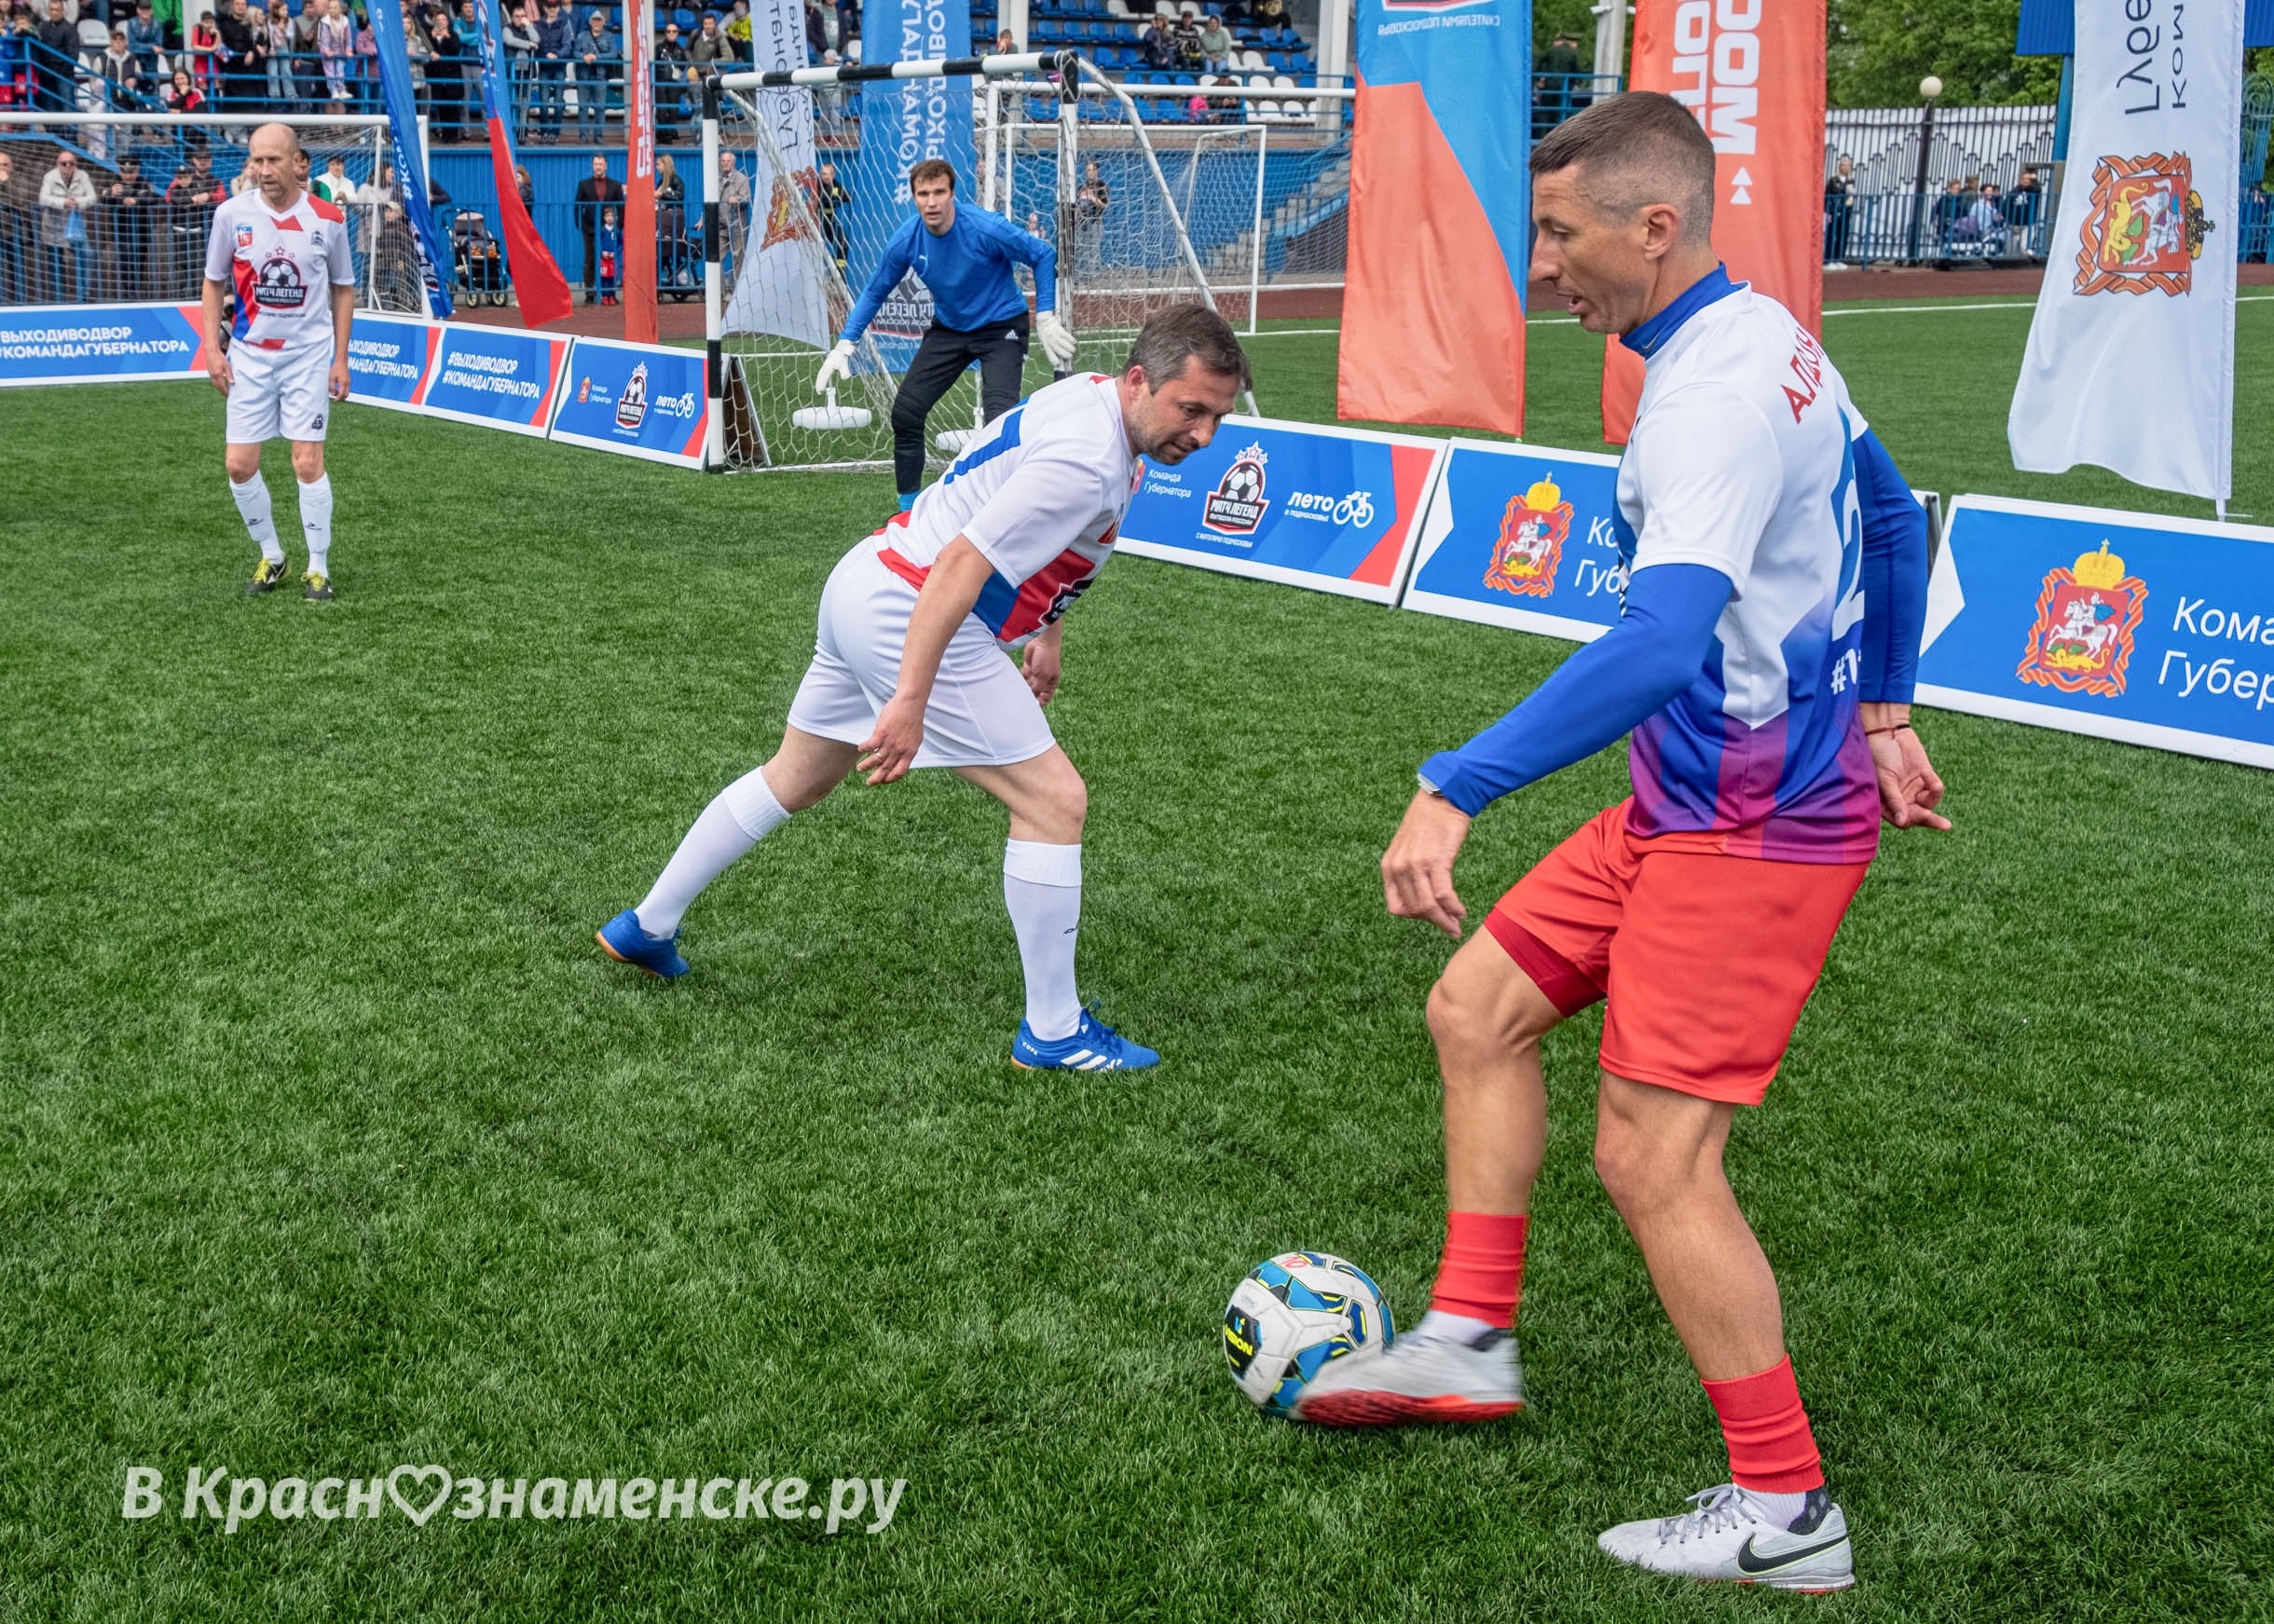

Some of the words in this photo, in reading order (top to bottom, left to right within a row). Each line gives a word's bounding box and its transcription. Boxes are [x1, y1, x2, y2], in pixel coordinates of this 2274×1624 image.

[0, 326, 132, 344] ВЫХОДИВОДВОР
[348, 339, 401, 358] ЫХОДИВОДВОР
[447, 351, 518, 375] #ВЫХОДИВОДВОР
[442, 369, 541, 400] #КОМАНДАГУБЕРНАТОРА
[1148, 469, 1182, 484] Команда
[1144, 481, 1192, 499] Губернатора
[1230, 502, 1260, 520] ЛЕГЕНД
[1287, 491, 1335, 512] лето
[1586, 515, 1618, 549] Ко
[1574, 559, 1621, 597] Губ
